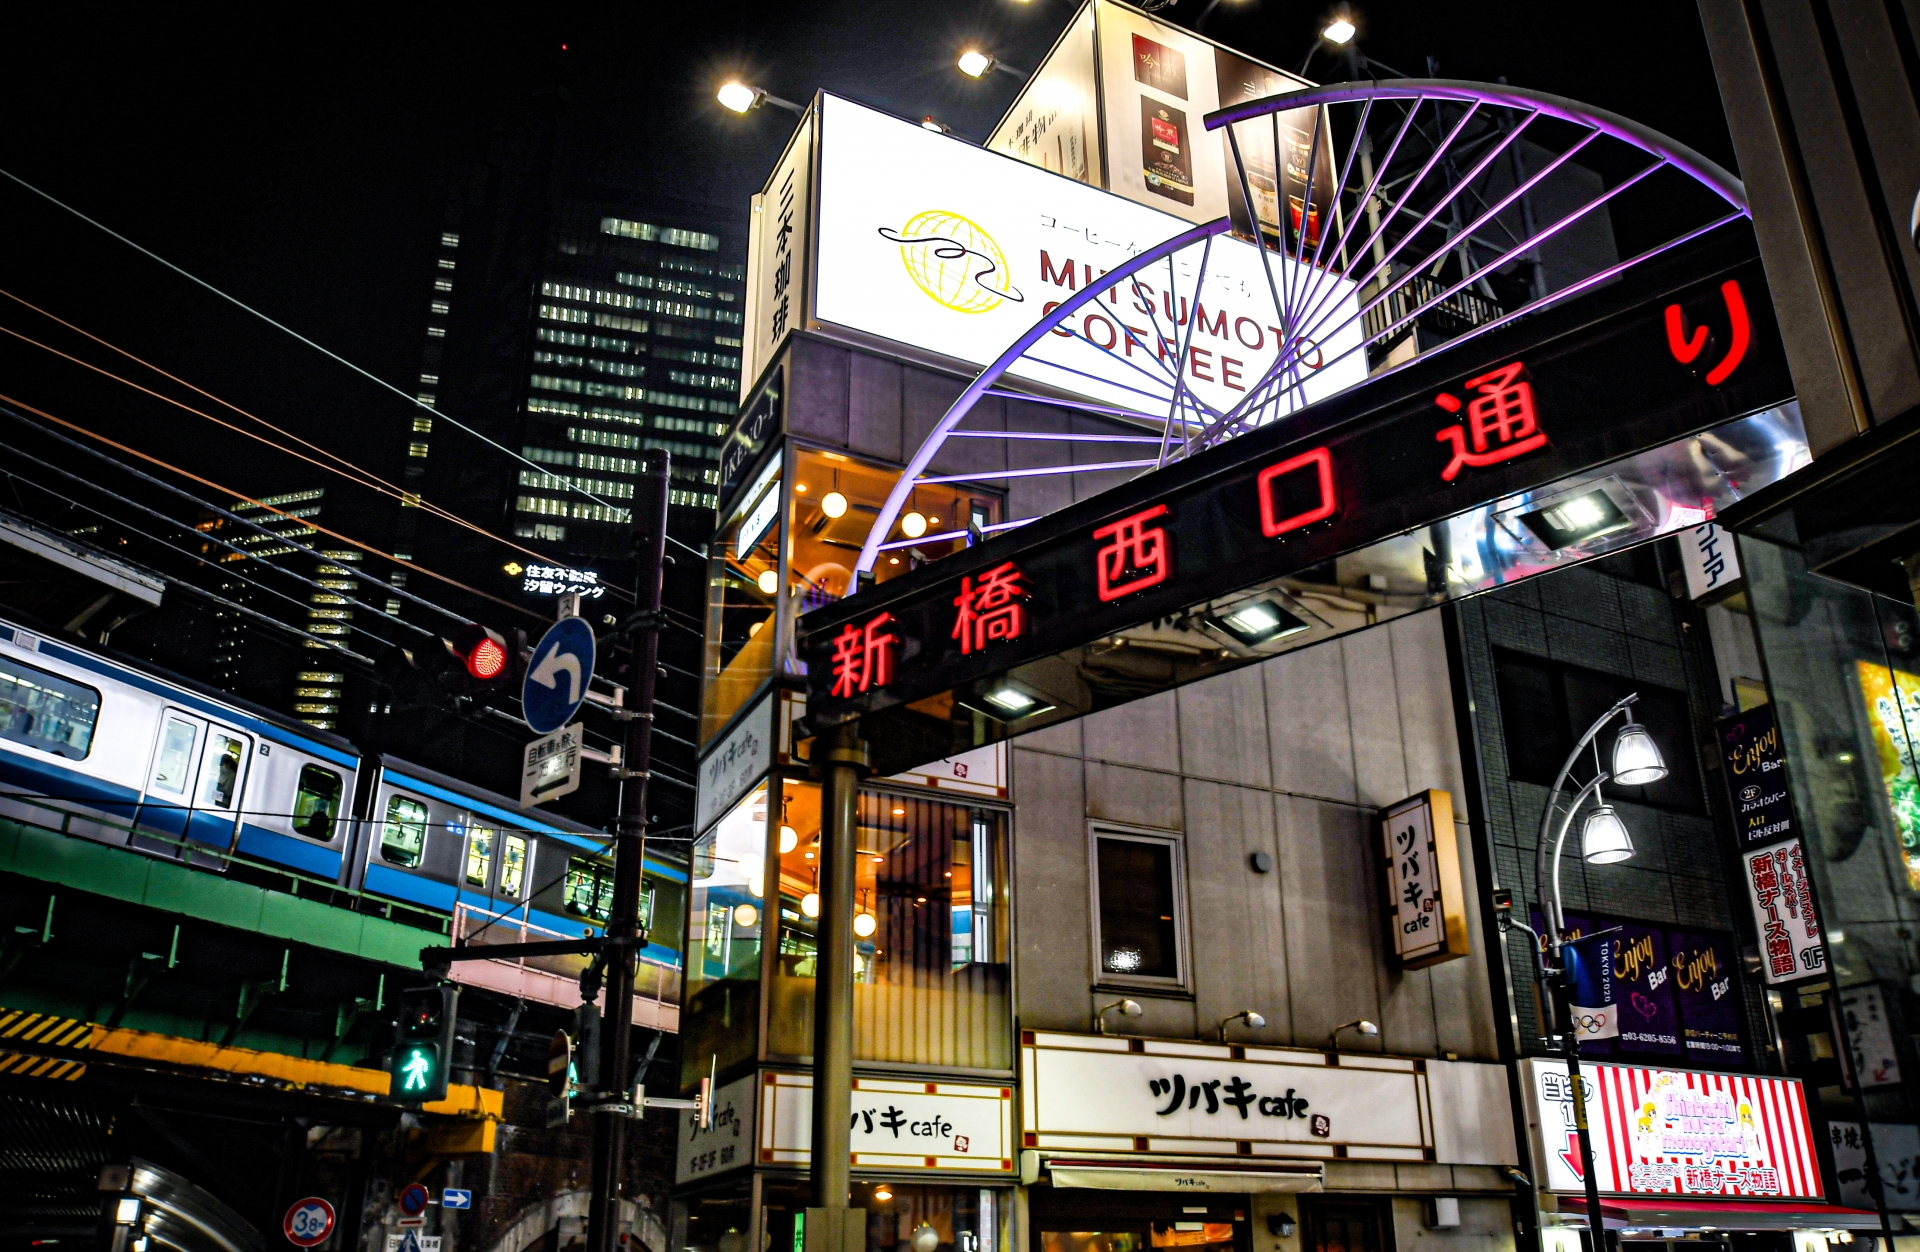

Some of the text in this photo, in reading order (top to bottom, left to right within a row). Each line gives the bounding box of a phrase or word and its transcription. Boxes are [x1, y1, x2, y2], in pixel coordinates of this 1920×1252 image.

[772, 167, 795, 345] 三本珈琲
[1039, 249, 1324, 370] MITSUMOTO
[1042, 301, 1246, 392] COFFEE
[831, 281, 1750, 699] 新橋西口通り
[526, 564, 597, 584] 住友不動産
[1729, 727, 1776, 774] Enjoy
[1397, 825, 1430, 934] ツバキ cafe
[1750, 852, 1797, 978] 新橋ナース物語
[1601, 942, 1612, 1003] TOKYO 2020
[1614, 935, 1655, 982] Enjoy
[1648, 966, 1668, 991] Bar
[1672, 947, 1730, 1001] Enjoy Bar
[1664, 1093, 1734, 1120] Shinbashi
[1682, 1118, 1726, 1135] nurse
[1662, 1132, 1747, 1160] monogatari
[1685, 1166, 1778, 1192] 新橋ナース物語
